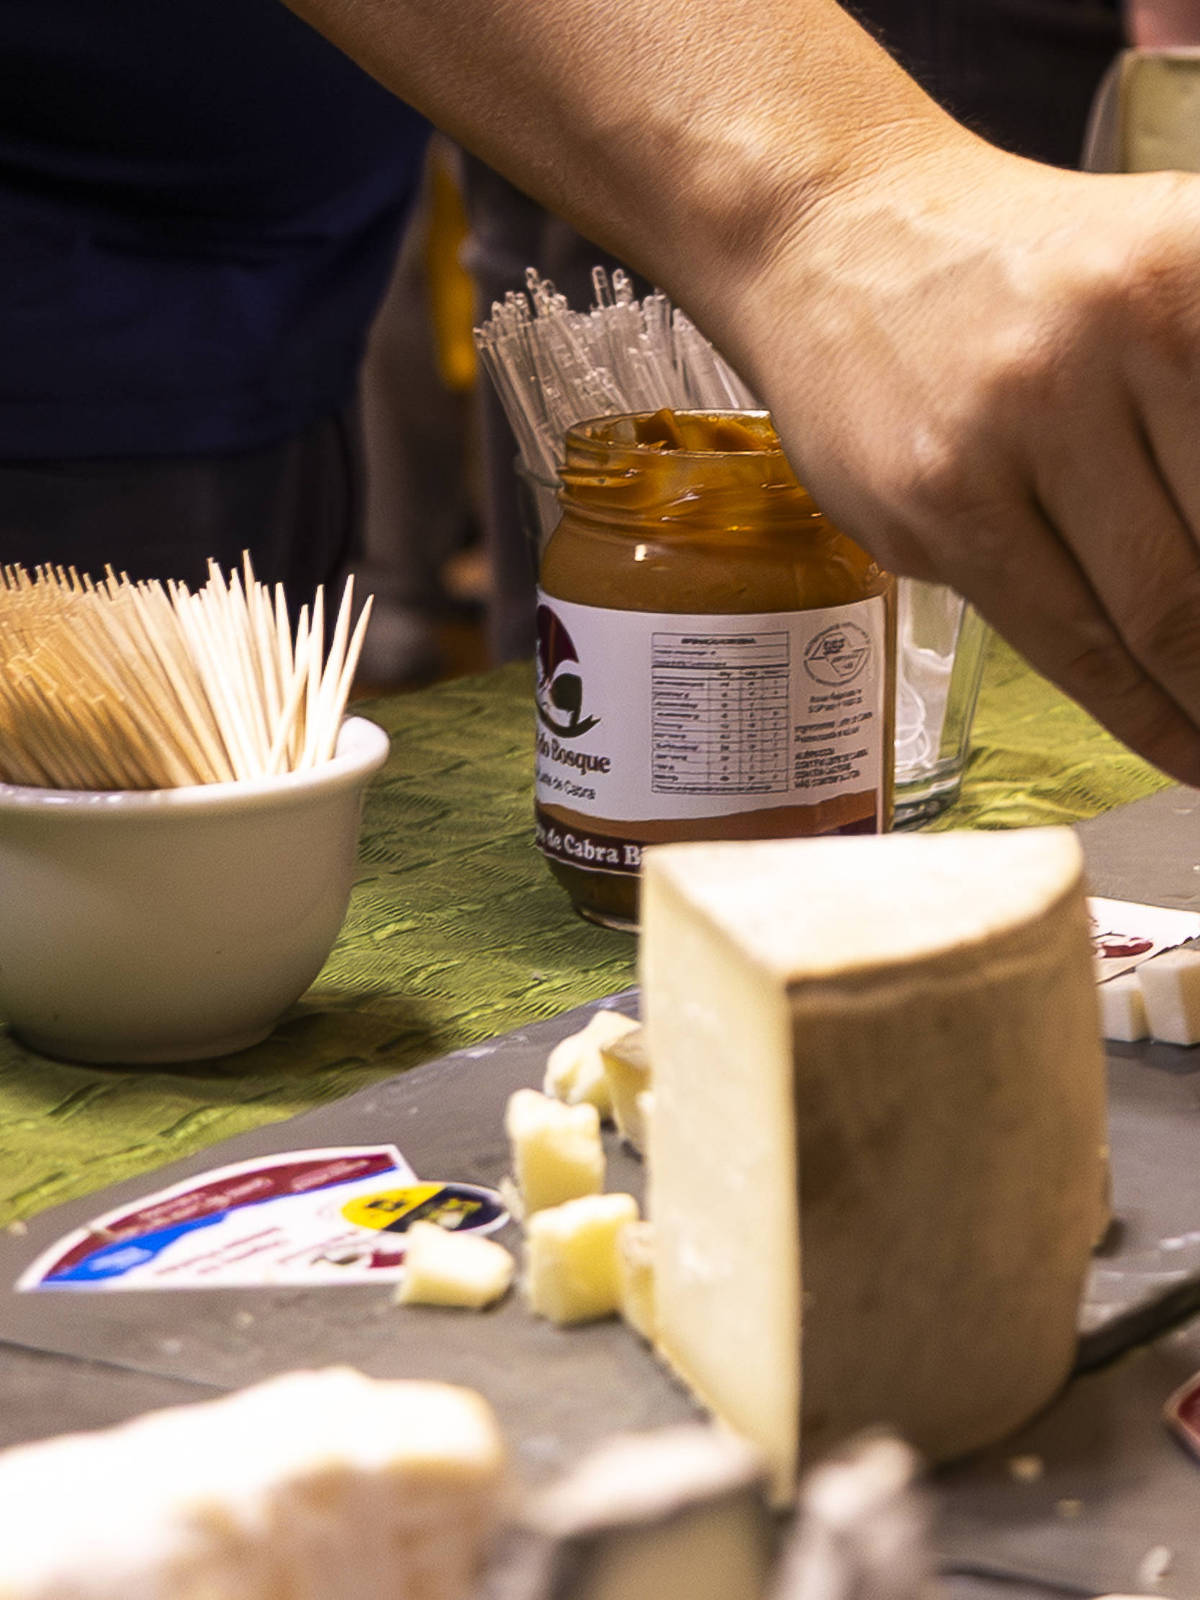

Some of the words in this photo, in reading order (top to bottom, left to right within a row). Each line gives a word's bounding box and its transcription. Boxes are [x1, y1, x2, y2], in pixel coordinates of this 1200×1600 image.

[551, 737, 611, 775] Bosque
[547, 828, 561, 850] de
[564, 833, 619, 864] Cabra
[623, 844, 641, 866] B
